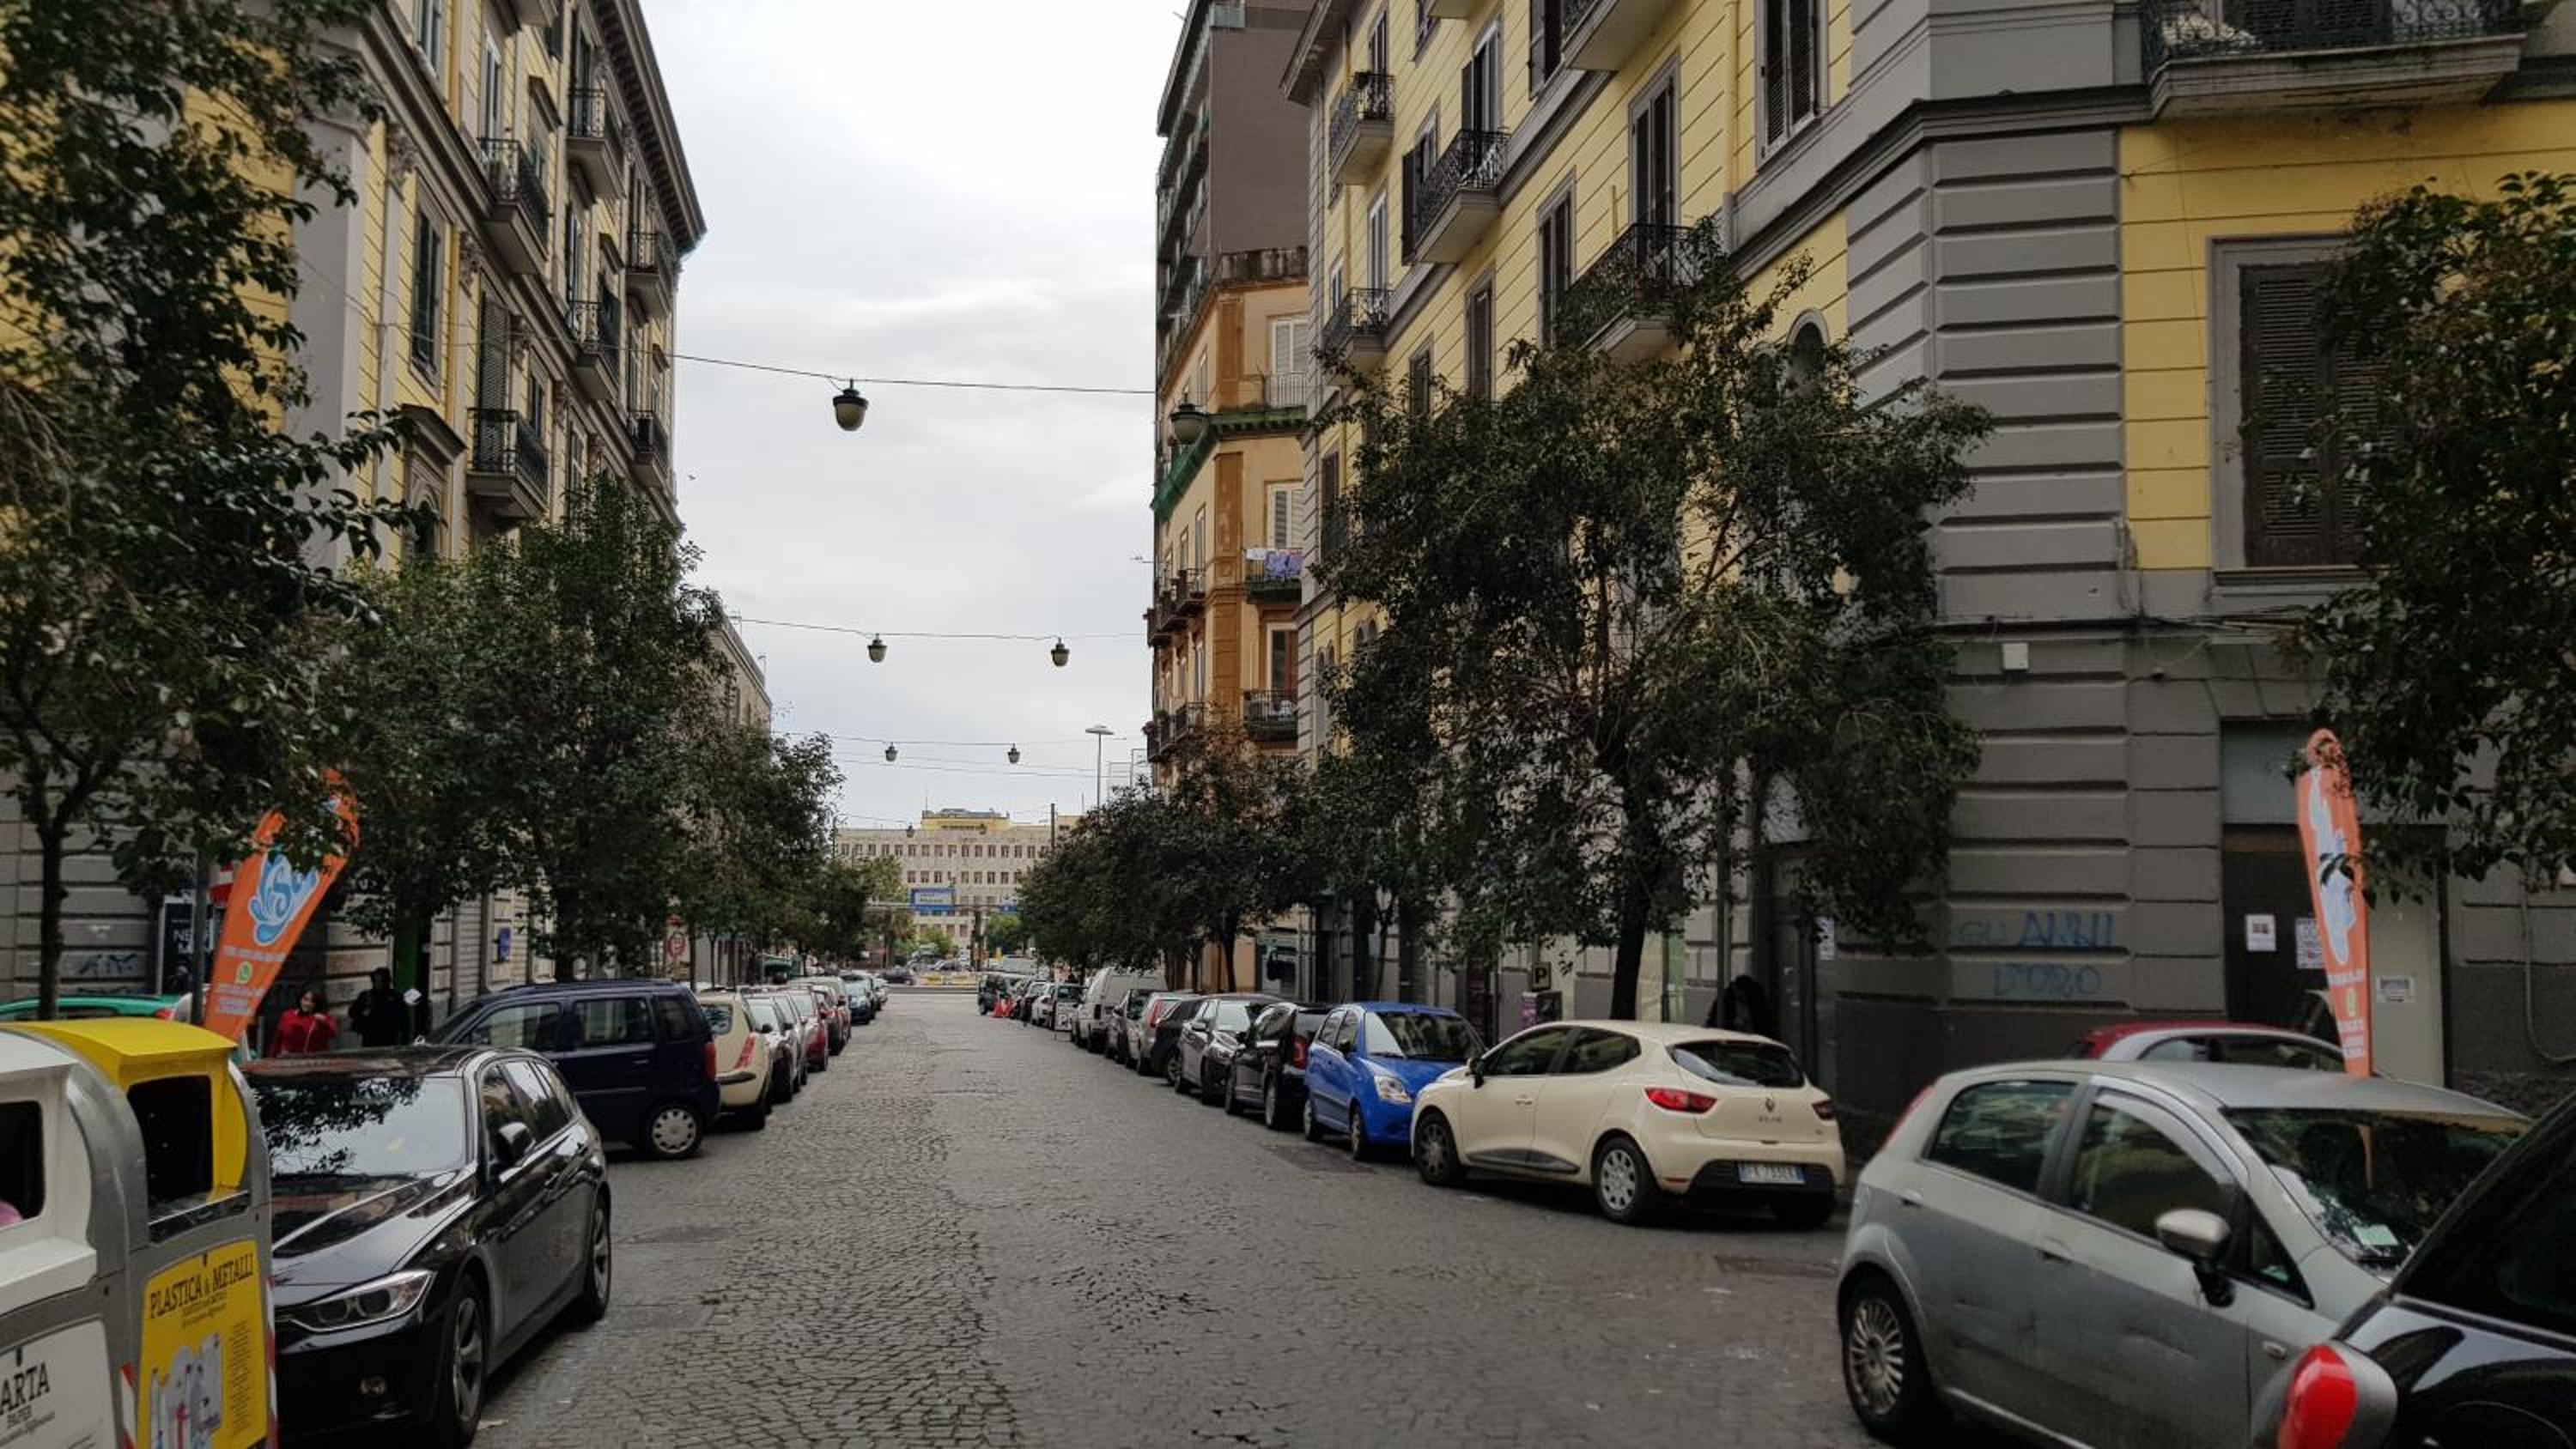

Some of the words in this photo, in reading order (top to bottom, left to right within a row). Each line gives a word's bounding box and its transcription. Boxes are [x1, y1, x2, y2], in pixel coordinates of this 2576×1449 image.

[1534, 967, 1548, 985] P
[150, 1274, 203, 1319] PLASTICA
[212, 1252, 254, 1291] METALLI
[0, 1361, 51, 1416] ARTA
